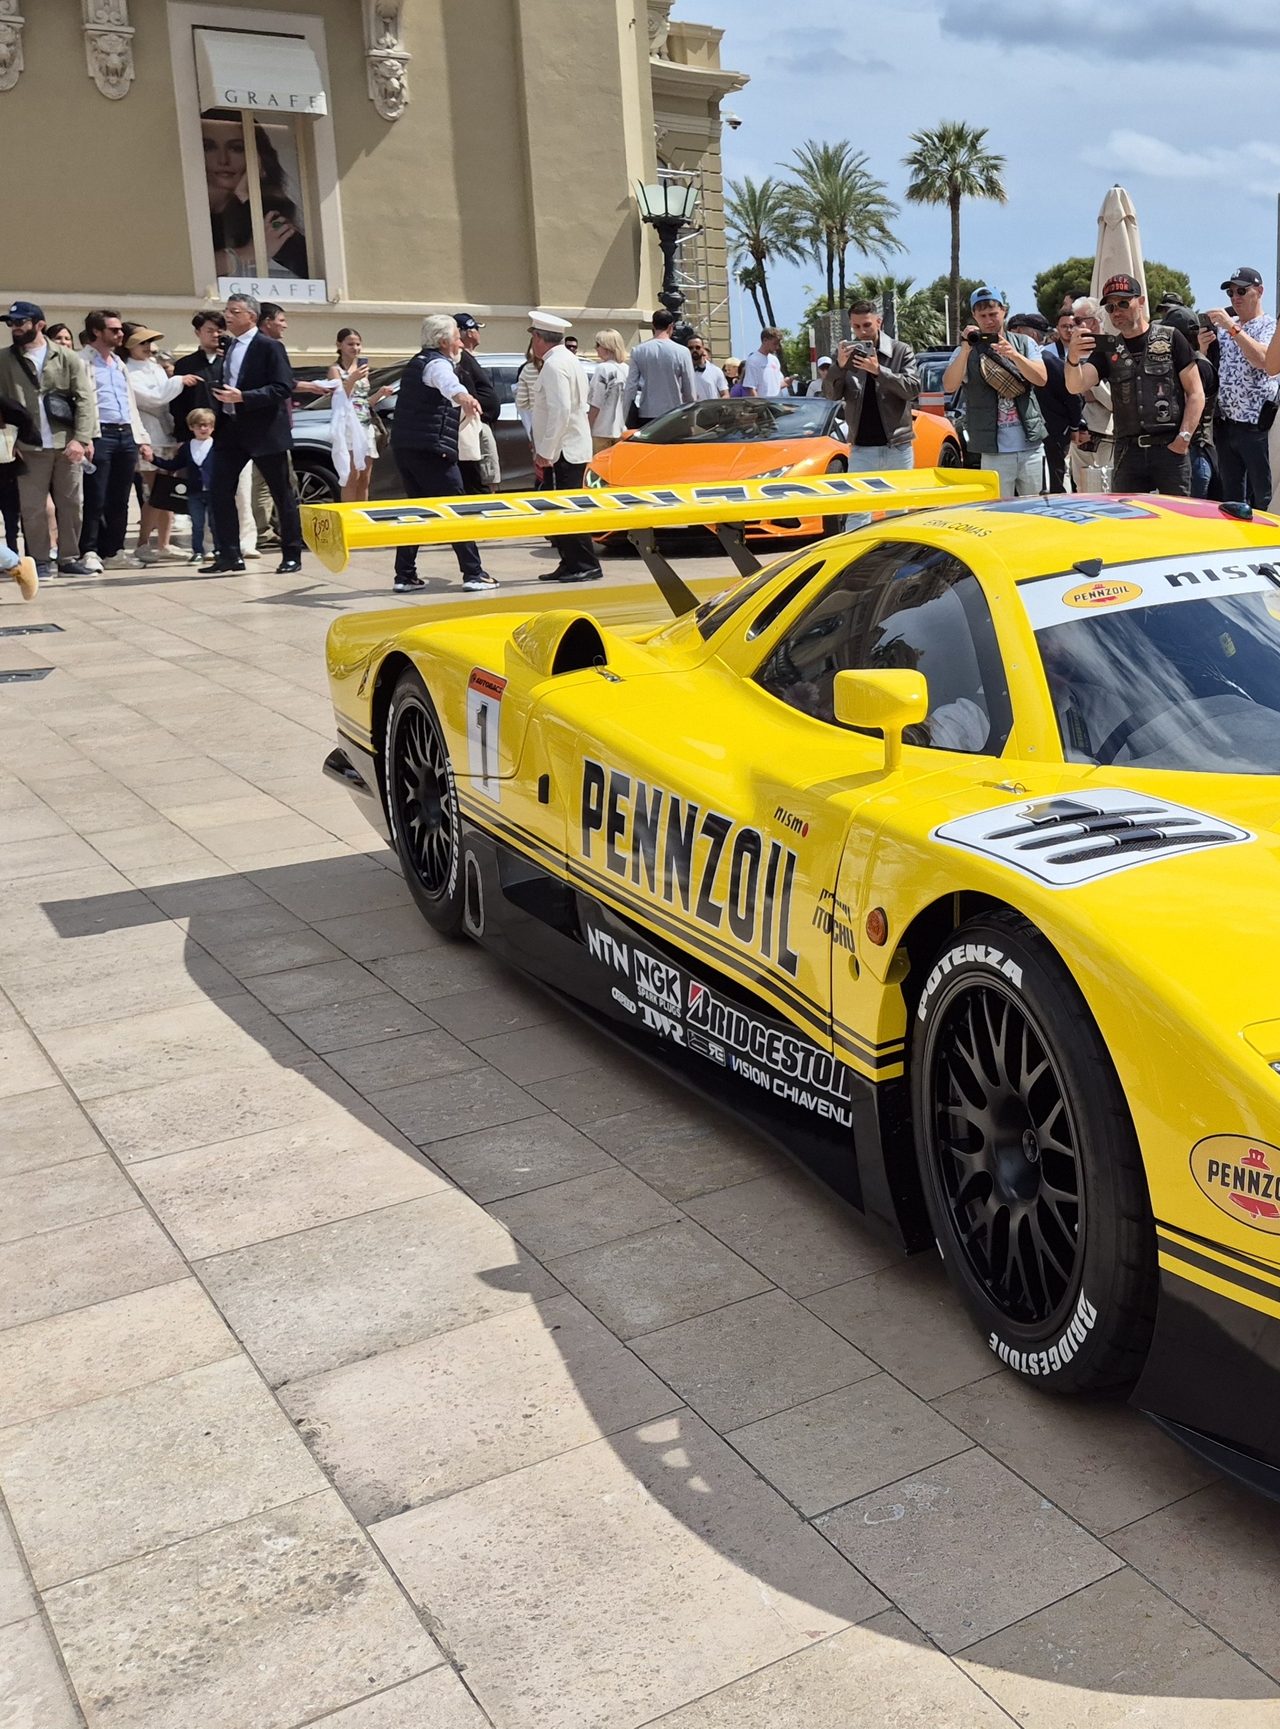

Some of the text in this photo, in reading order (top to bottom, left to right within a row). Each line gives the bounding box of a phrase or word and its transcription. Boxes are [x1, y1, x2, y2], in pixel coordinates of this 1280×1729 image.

[224, 89, 320, 108] GRAFF
[229, 282, 317, 297] GRAFF
[947, 522, 992, 537] COMAS
[1073, 585, 1130, 603] PENNZOIL
[476, 677, 503, 694] AUTOBACS
[476, 701, 489, 790] 1
[773, 806, 809, 838] nismo
[581, 756, 799, 981] PENNZOIL
[587, 923, 630, 977] NTN
[635, 951, 682, 1007] NGK
[917, 943, 1023, 1022] POTENZA
[637, 985, 658, 1005] SPARK
[659, 998, 681, 1018] PLUGS
[637, 1001, 687, 1047] TWR
[730, 1054, 770, 1090] VISION
[988, 1286, 1098, 1376] BRIDGESTONE
